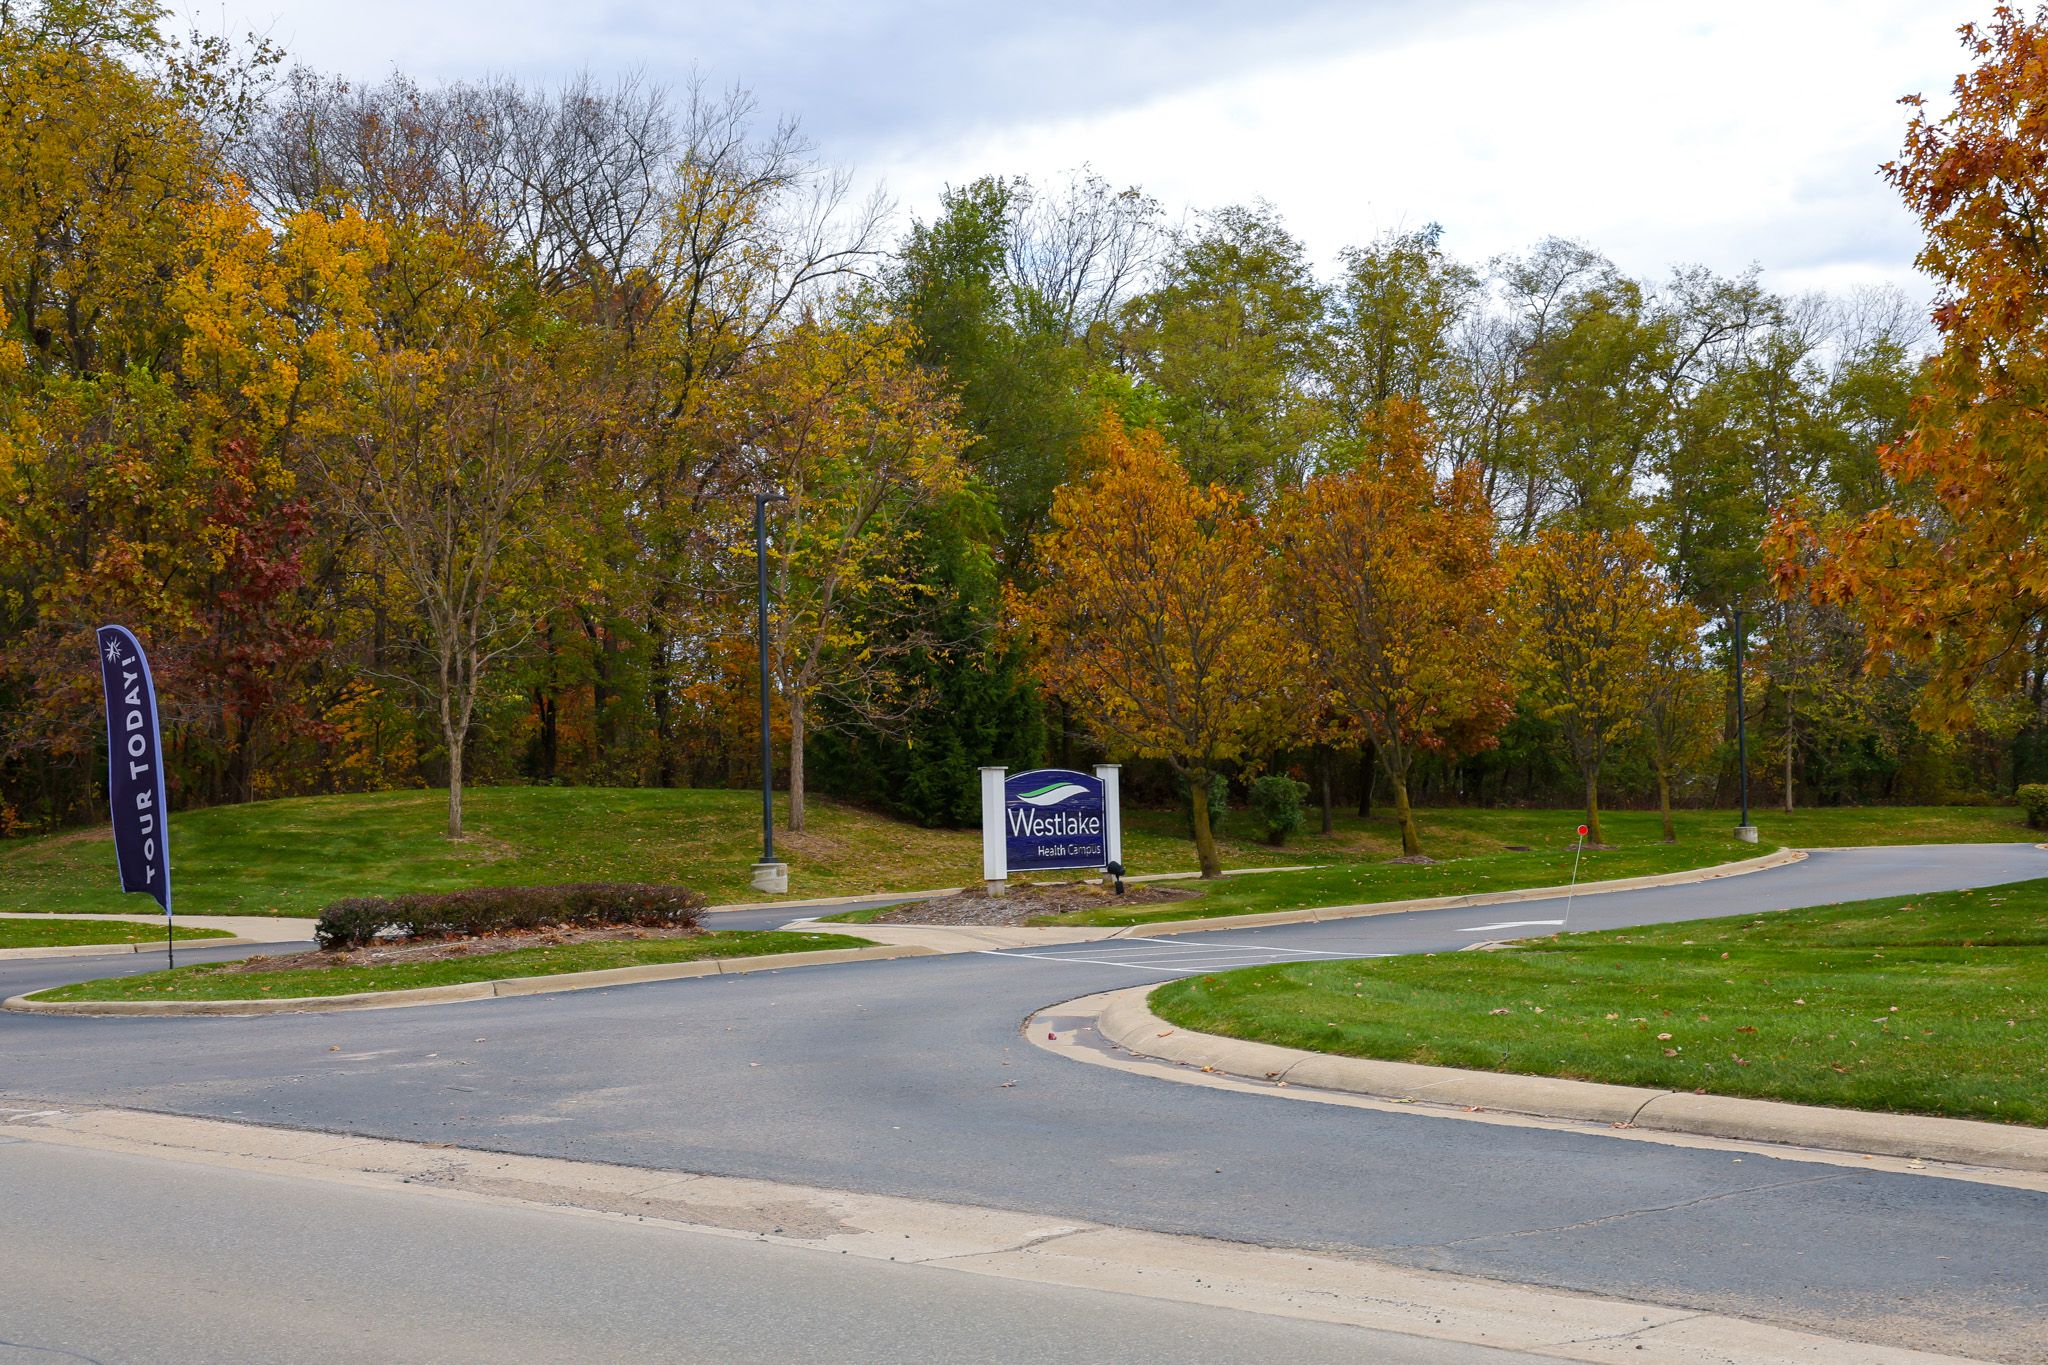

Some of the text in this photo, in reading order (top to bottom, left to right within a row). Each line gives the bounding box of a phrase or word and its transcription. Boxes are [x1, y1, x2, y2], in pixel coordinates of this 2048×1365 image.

[122, 655, 156, 884] TOUR TODAY!
[1007, 808, 1100, 837] Westlake
[1038, 844, 1101, 856] Health Campus
